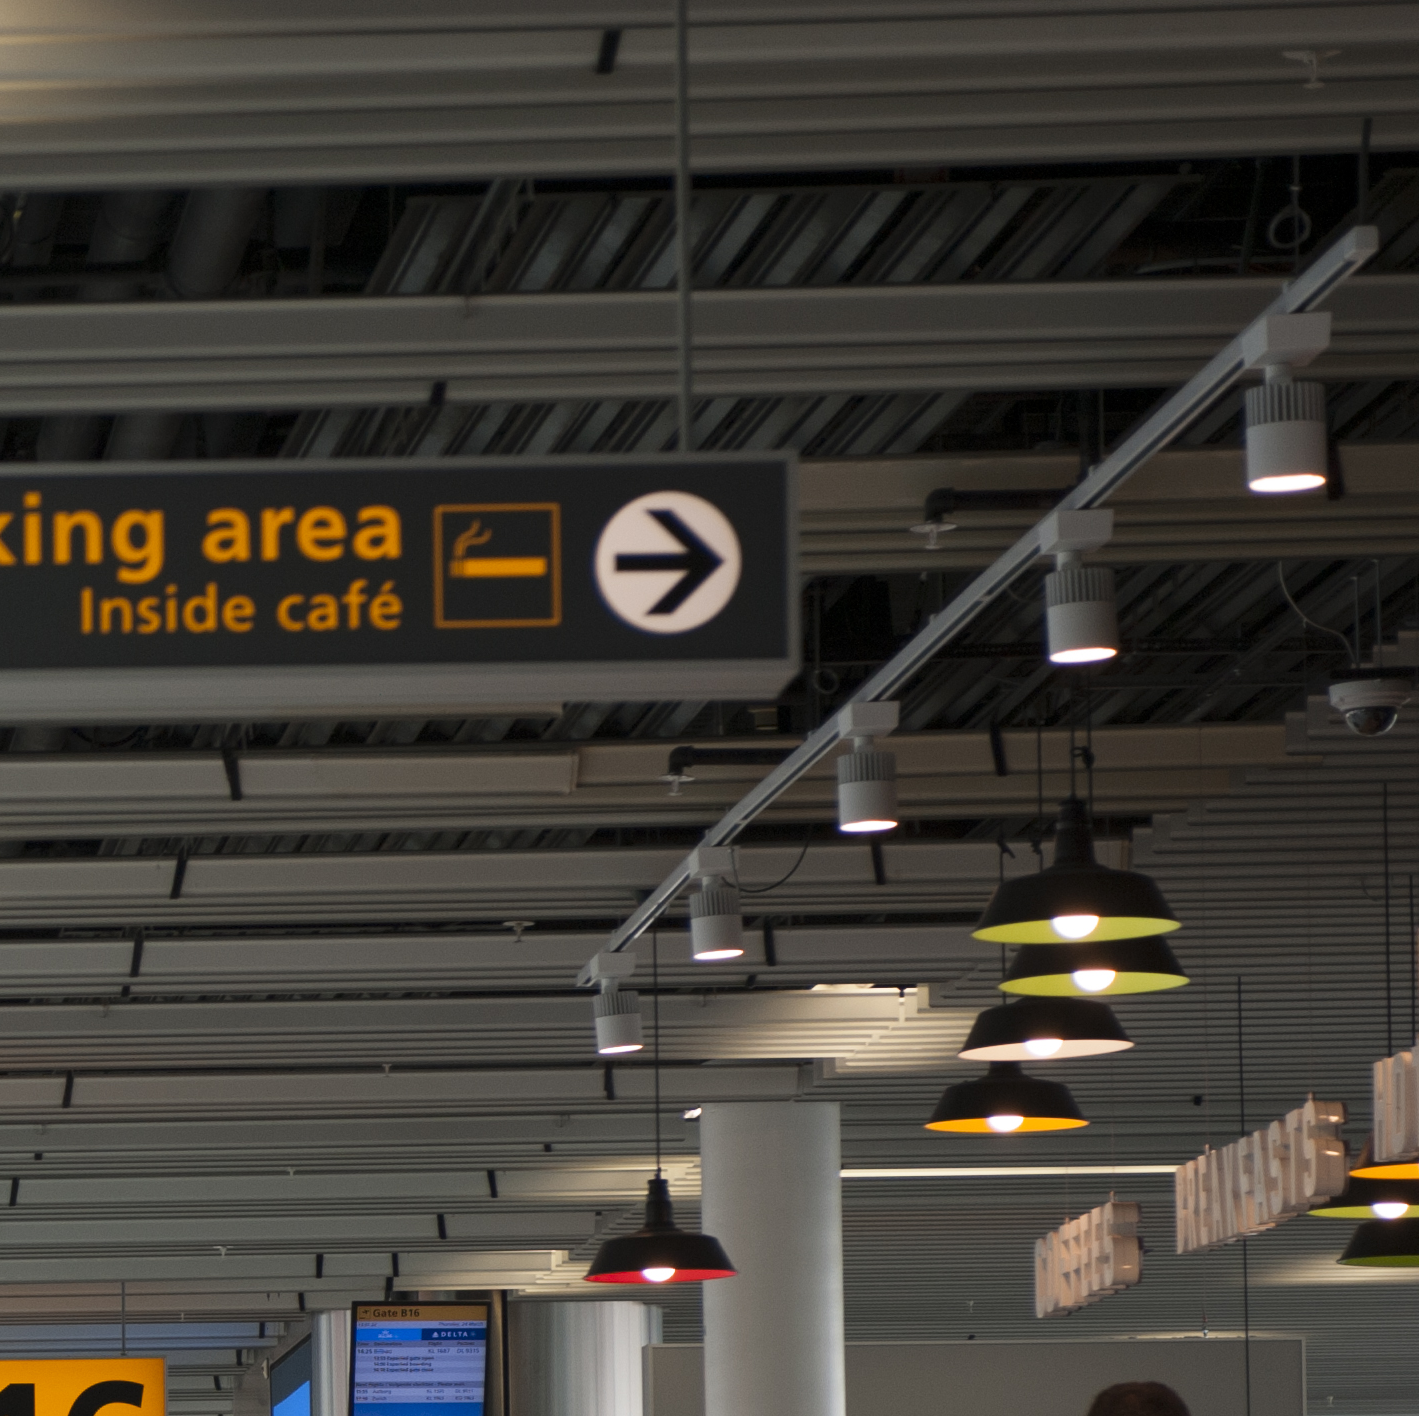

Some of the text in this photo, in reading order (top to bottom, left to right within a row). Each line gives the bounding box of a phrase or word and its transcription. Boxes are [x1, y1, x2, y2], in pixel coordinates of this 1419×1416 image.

[203, 505, 403, 563] area
[80, 581, 403, 637] Inside café
[373, 1309, 420, 1317] Gate B16
